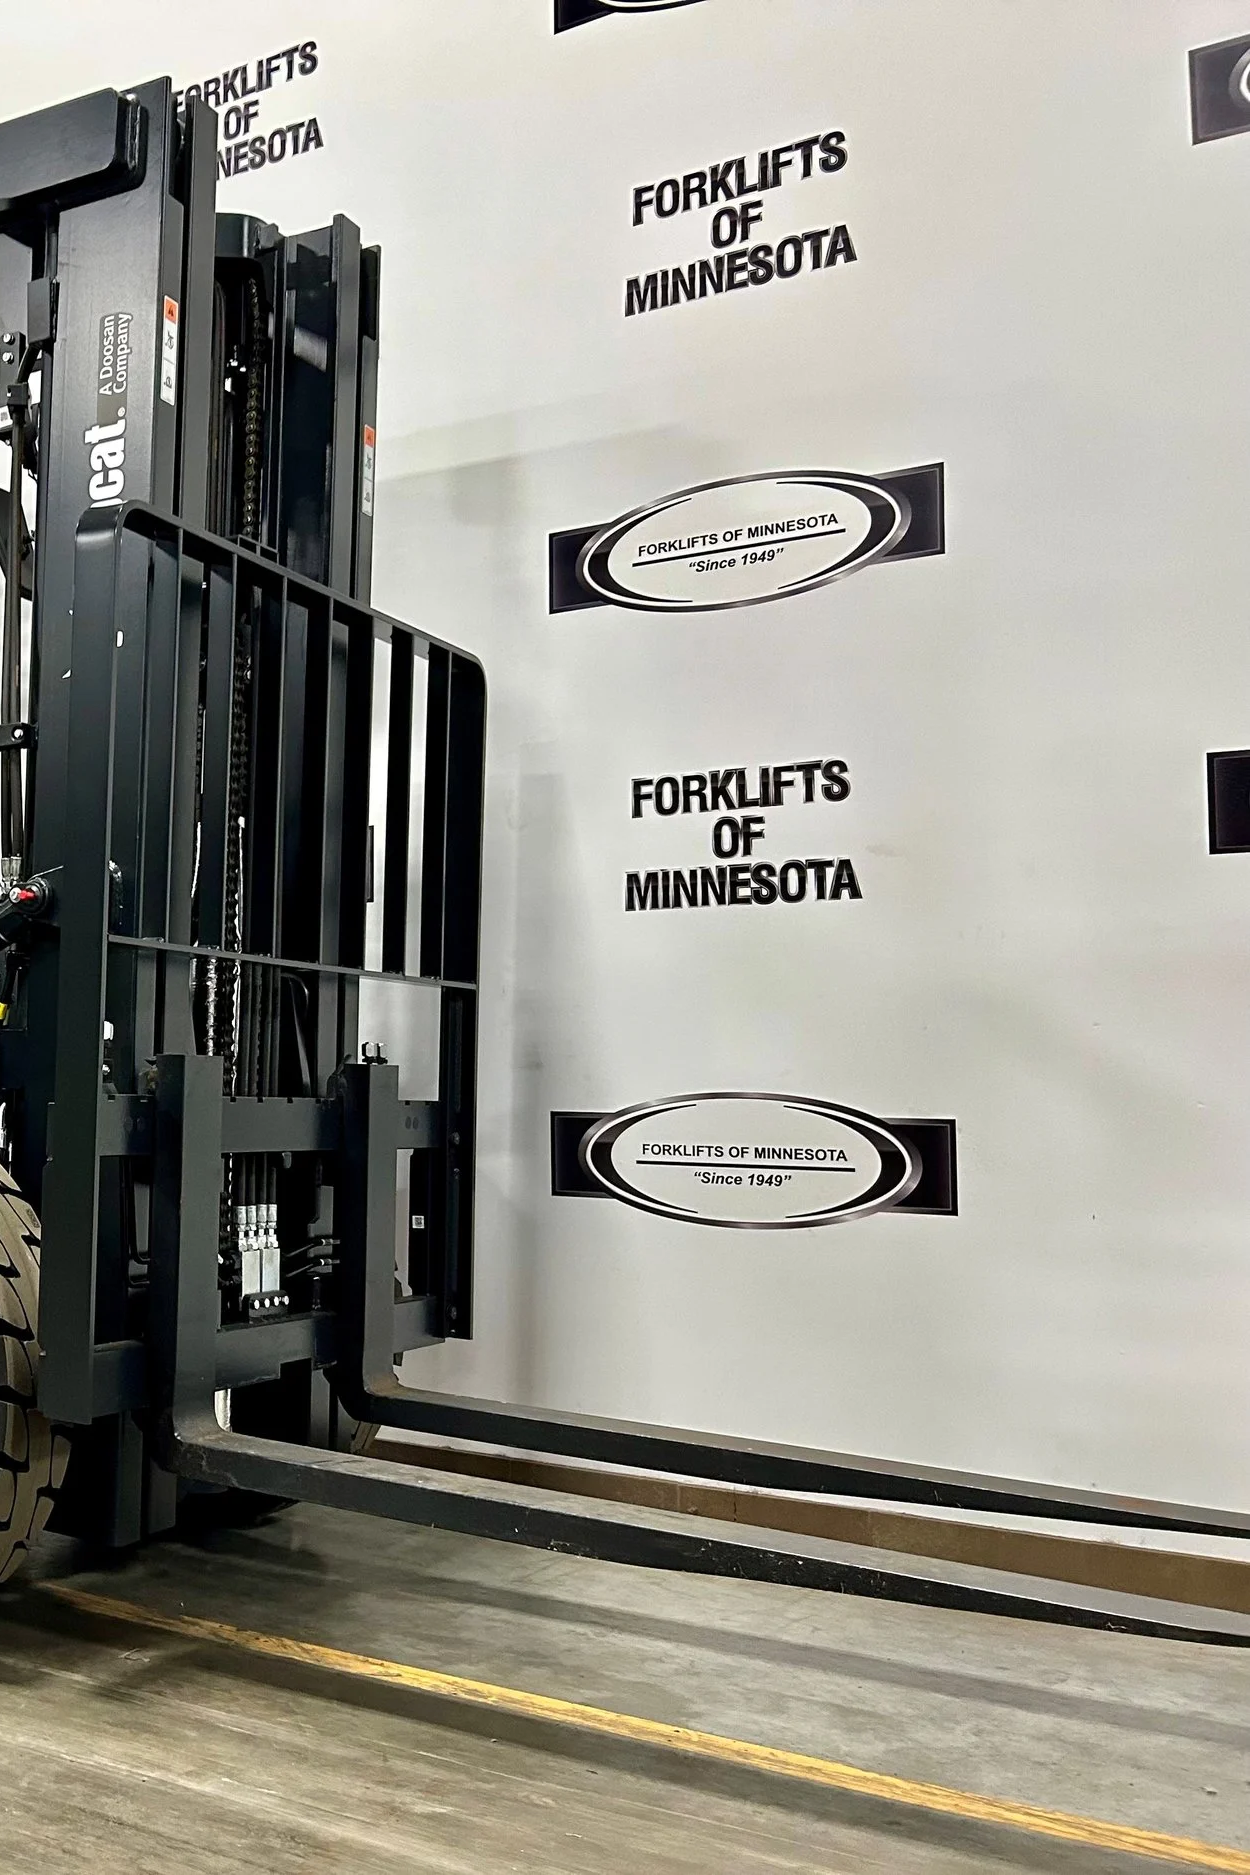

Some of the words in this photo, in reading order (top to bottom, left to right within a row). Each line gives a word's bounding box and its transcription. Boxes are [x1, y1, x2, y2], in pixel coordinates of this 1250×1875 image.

[224, 100, 259, 141] OF
[217, 118, 324, 181] NESOTA
[632, 131, 848, 226] FORKLIFTS
[711, 199, 763, 249] OF
[624, 224, 858, 317] MINNESOTA
[100, 315, 115, 380] Doosan
[113, 313, 133, 394] Company
[99, 382, 113, 396] A
[638, 534, 718, 557] FORKLIFTS
[722, 529, 743, 544] OF
[748, 513, 839, 538] MINNESOTA
[631, 759, 851, 818] FORKLIFTS
[712, 815, 765, 859] OF
[625, 857, 863, 911] MINNESOTA
[642, 1143, 724, 1158] FORKLIFTS
[728, 1146, 750, 1159] OF
[754, 1147, 848, 1162] MINNESOTA
